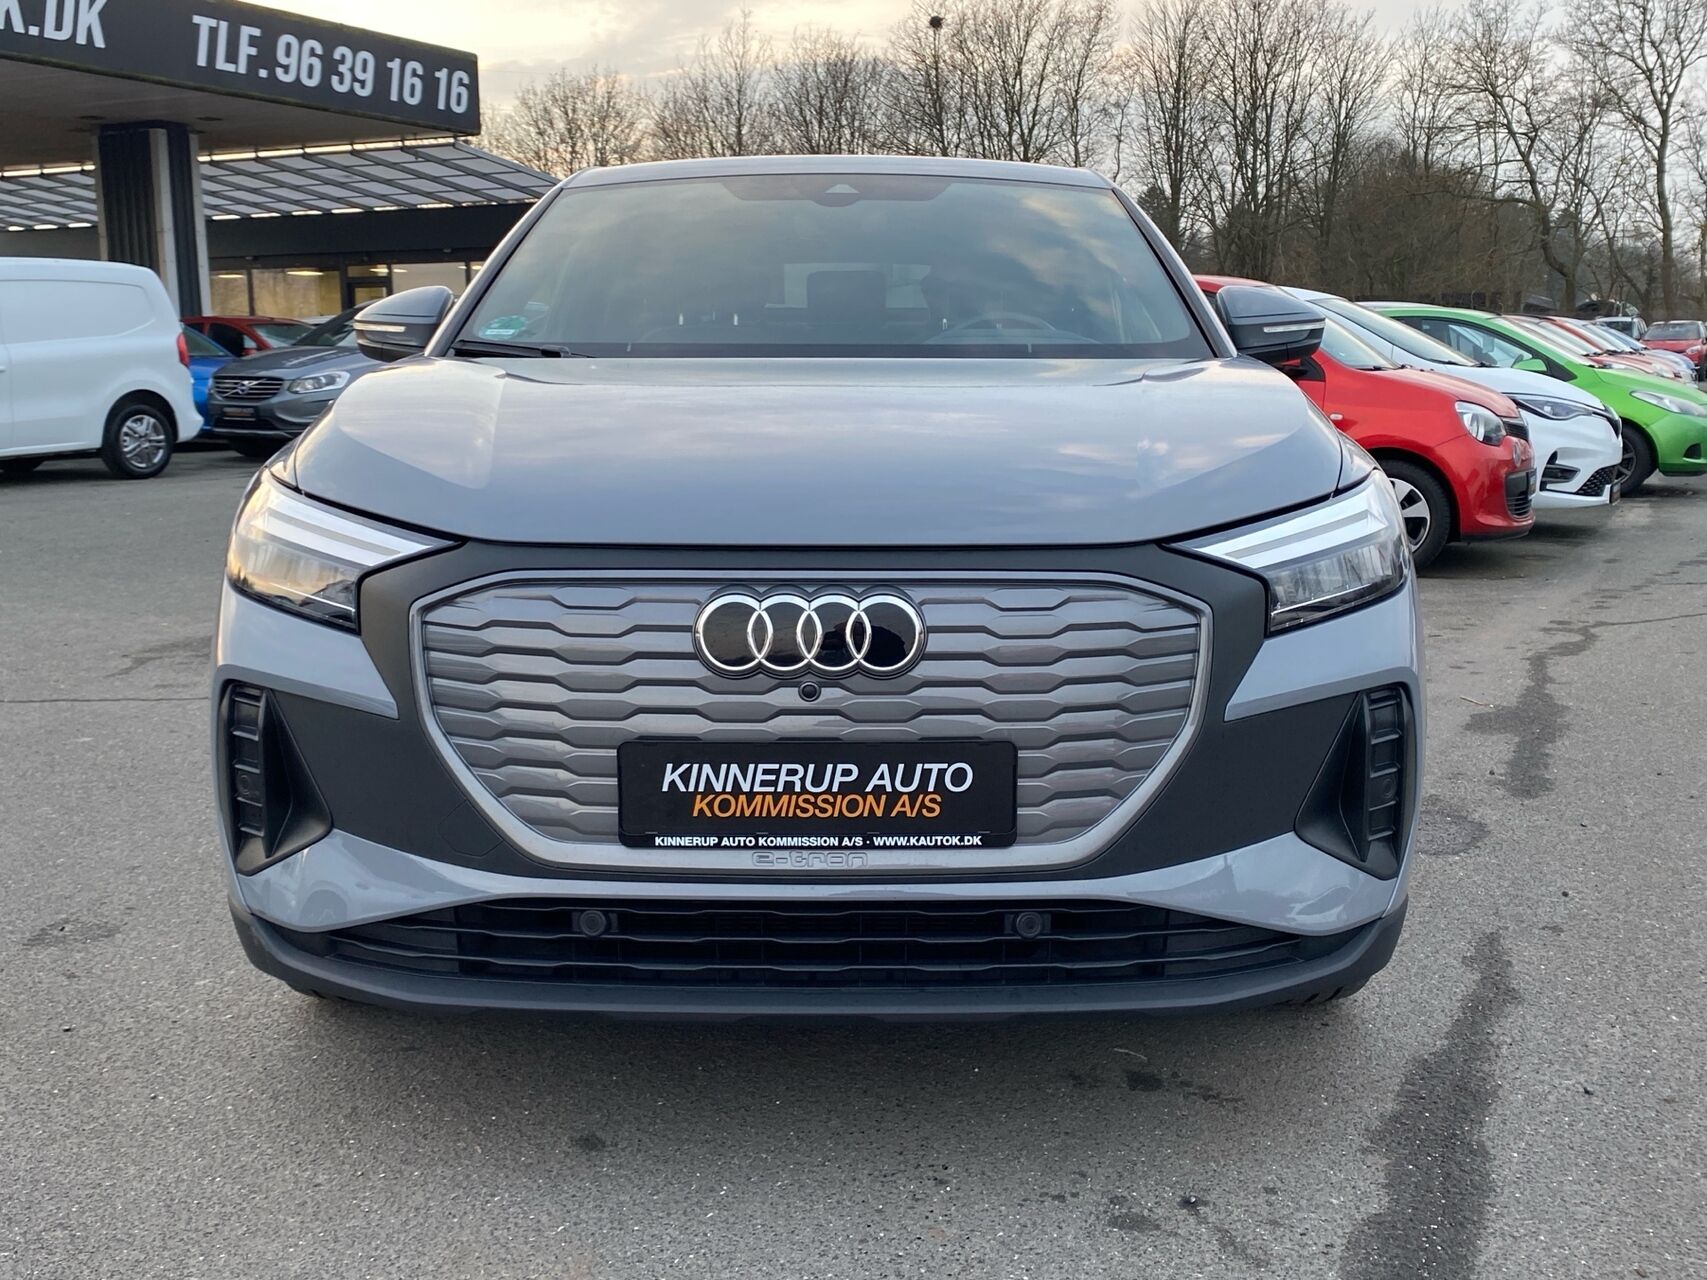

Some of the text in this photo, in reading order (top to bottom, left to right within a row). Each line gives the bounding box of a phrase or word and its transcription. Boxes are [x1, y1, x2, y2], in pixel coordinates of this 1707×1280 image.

[331, 46, 375, 97] 39
[386, 58, 424, 105] 16
[434, 67, 470, 114] 16
[661, 762, 974, 793] KINNERUP AUTO
[692, 794, 942, 818] KOMMISSION A/S
[655, 835, 983, 847] KINNERUP AUTO KOMMISSION A/S WWW.KAUTOK.DK
[751, 851, 869, 868] e-tron
